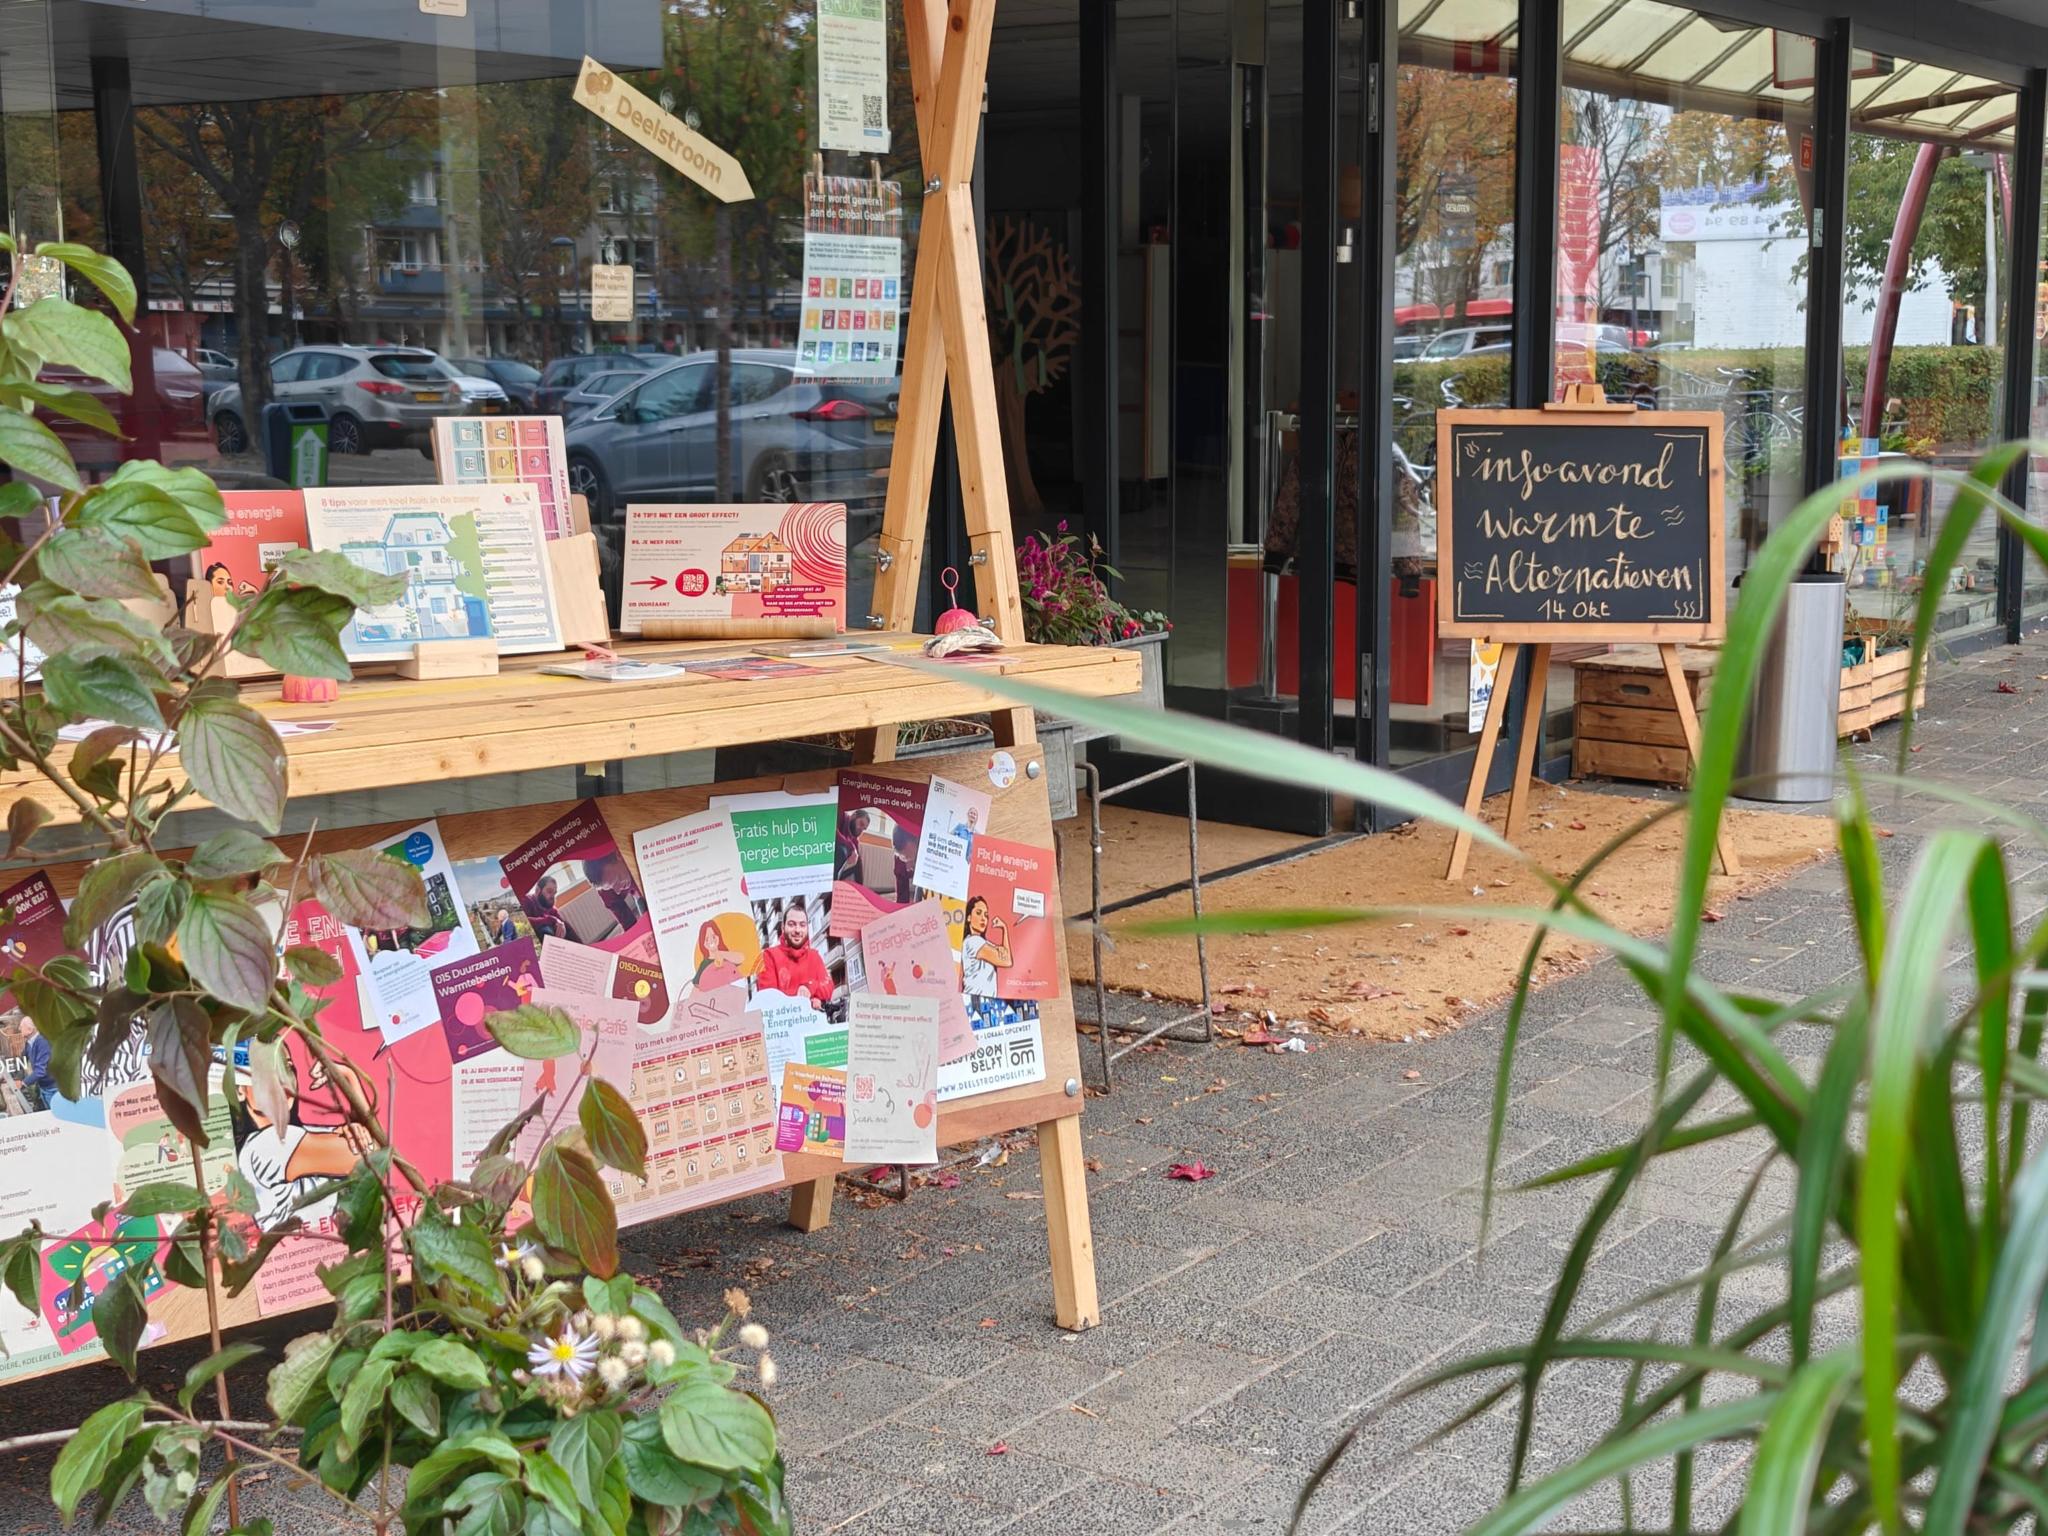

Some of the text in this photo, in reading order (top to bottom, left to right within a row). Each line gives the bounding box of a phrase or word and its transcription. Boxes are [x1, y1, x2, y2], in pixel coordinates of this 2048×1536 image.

[616, 95, 722, 185] Deelstroom
[810, 208, 825, 219] aan
[826, 208, 837, 219] de
[838, 208, 863, 220] Global
[236, 506, 285, 521] energie
[329, 497, 347, 510] tips
[1484, 550, 1693, 595] Alternatieven
[1537, 599, 1612, 620] 14 Okt
[842, 777, 912, 797] Energiehulp Klusdag
[873, 797, 890, 806] gaan
[900, 800, 914, 810] wijk
[732, 816, 817, 840] Gratis hulp bij
[505, 816, 582, 872] Energiehulp Klusdag
[547, 844, 566, 861] gaan
[565, 837, 576, 847] de
[574, 827, 591, 842] wijk
[590, 822, 598, 832] in
[738, 843, 779, 864] nergie
[991, 850, 1001, 864] je
[1003, 855, 1038, 871] energie
[976, 863, 1017, 881] rekening!
[24, 886, 34, 898] JE
[33, 880, 45, 892] ER
[16, 890, 49, 914] OOK BIJ?
[868, 928, 913, 955] Energie
[912, 915, 938, 937] Café
[435, 955, 500, 985] 015 Duurzaam
[438, 965, 512, 998] Warmtebeelden
[776, 1004, 802, 1016] advies
[599, 1018, 628, 1036] Café
[767, 1013, 818, 1029] Energiehulp
[634, 1024, 720, 1051] tips met een groot effect
[766, 1030, 789, 1040] amza
[971, 1056, 1002, 1073] DELFT
[1010, 1048, 1035, 1066] om
[6, 1127, 61, 1143] aantrekkelijk uit
[276, 1242, 325, 1261] een persoonlijk
[260, 1269, 274, 1279] aan
[275, 1265, 289, 1276] huis
[290, 1261, 307, 1273] door
[307, 1259, 321, 1269] een
[262, 1270, 316, 1291] Aan deze servic
[263, 1284, 325, 1305] Kijk op 015Duurza
[22, 1353, 51, 1365] KOELERE
